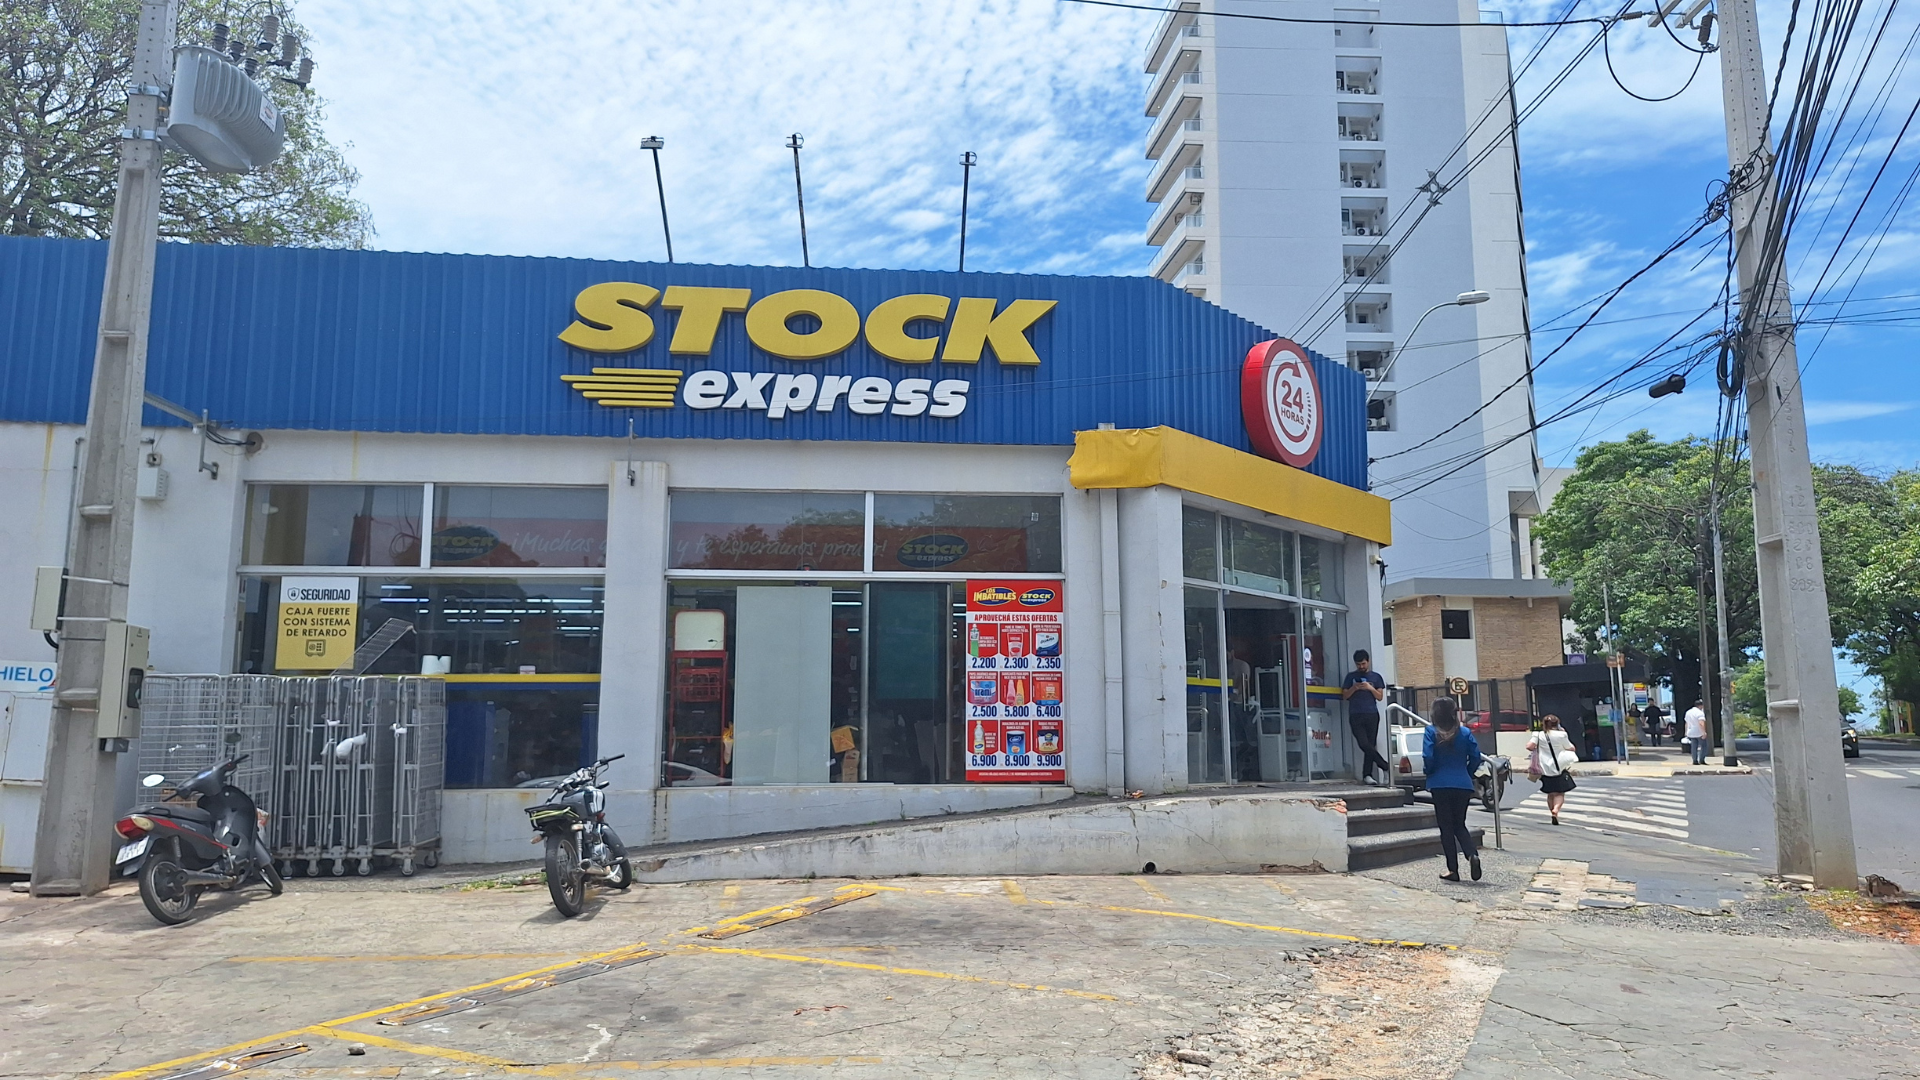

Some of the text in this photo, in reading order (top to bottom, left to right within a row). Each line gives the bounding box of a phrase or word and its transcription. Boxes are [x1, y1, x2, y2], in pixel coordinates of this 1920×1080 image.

[557, 281, 1059, 365] STOCK
[682, 369, 970, 418] express
[1281, 380, 1304, 413] 24
[1281, 407, 1305, 426] HORAS
[718, 537, 817, 564] esperamos
[901, 543, 966, 555] STOCK
[916, 554, 953, 562] express
[300, 588, 351, 601] SEGURIDAD
[973, 591, 1017, 602] IMBATIBLES
[286, 607, 350, 616] CAJA FUERTE
[283, 618, 351, 626] CON SISTEMA
[974, 613, 1058, 622] APROVECHÁ ESTAS OFERTAS
[286, 629, 347, 637] DE RETARDO
[972, 657, 997, 669] 2.200
[1004, 657, 1029, 669] 2.300
[1036, 657, 1061, 669] 2.350
[0, 666, 53, 682] HIELO
[972, 706, 997, 717] 2.500
[1004, 706, 1029, 717] 5.800
[1036, 706, 1061, 717] 6.400
[972, 755, 997, 766] 6.900
[1004, 755, 1030, 766] 8.900
[1037, 755, 1062, 766] 9.900
